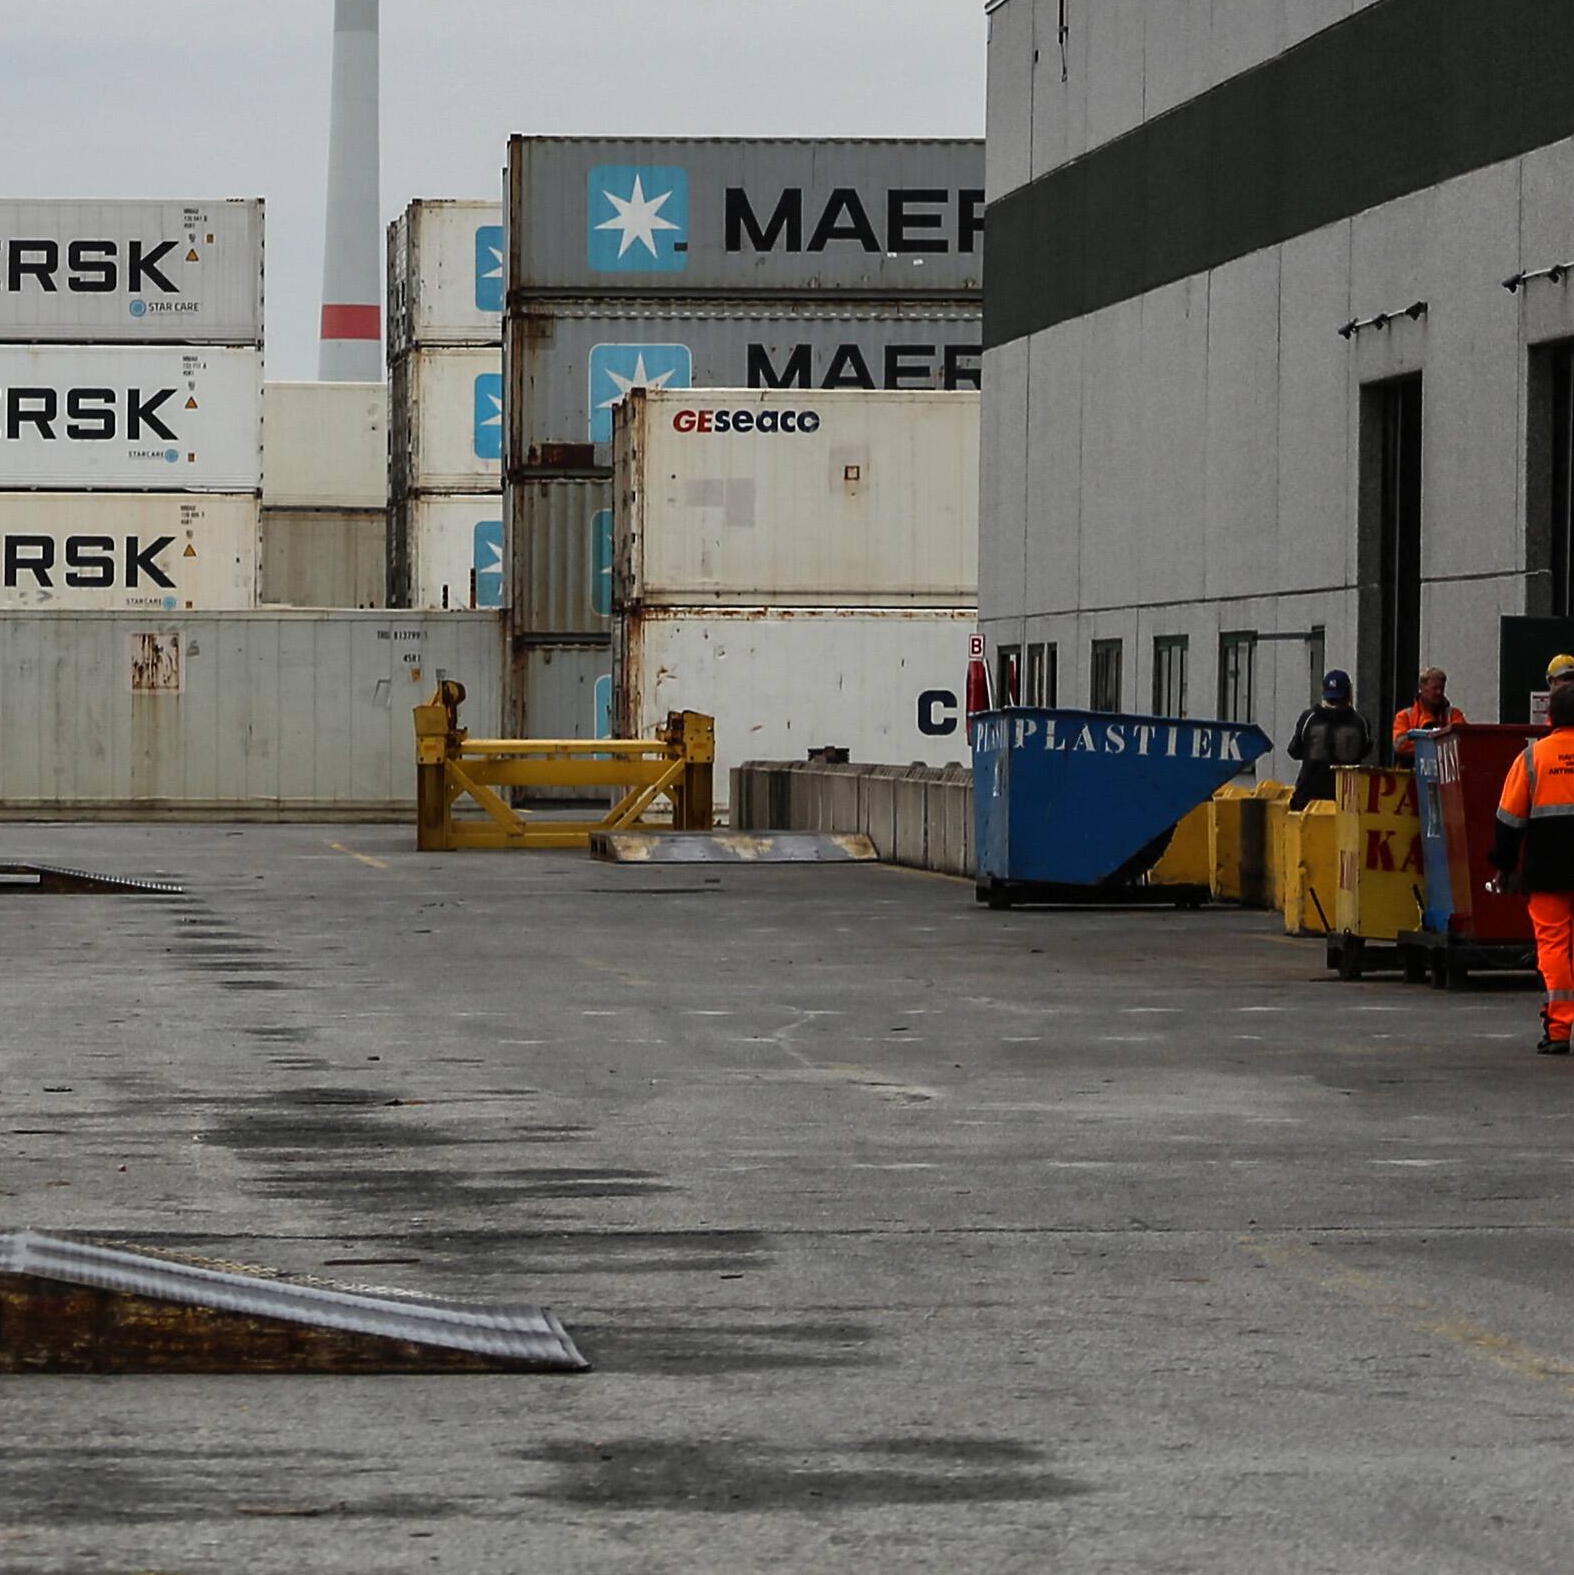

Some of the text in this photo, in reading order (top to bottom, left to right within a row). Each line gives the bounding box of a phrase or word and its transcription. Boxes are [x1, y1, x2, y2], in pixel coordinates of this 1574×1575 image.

[148, 302, 200, 312] STAR CARE
[971, 637, 982, 655] B
[1013, 718, 1243, 761] PLASTIEK
